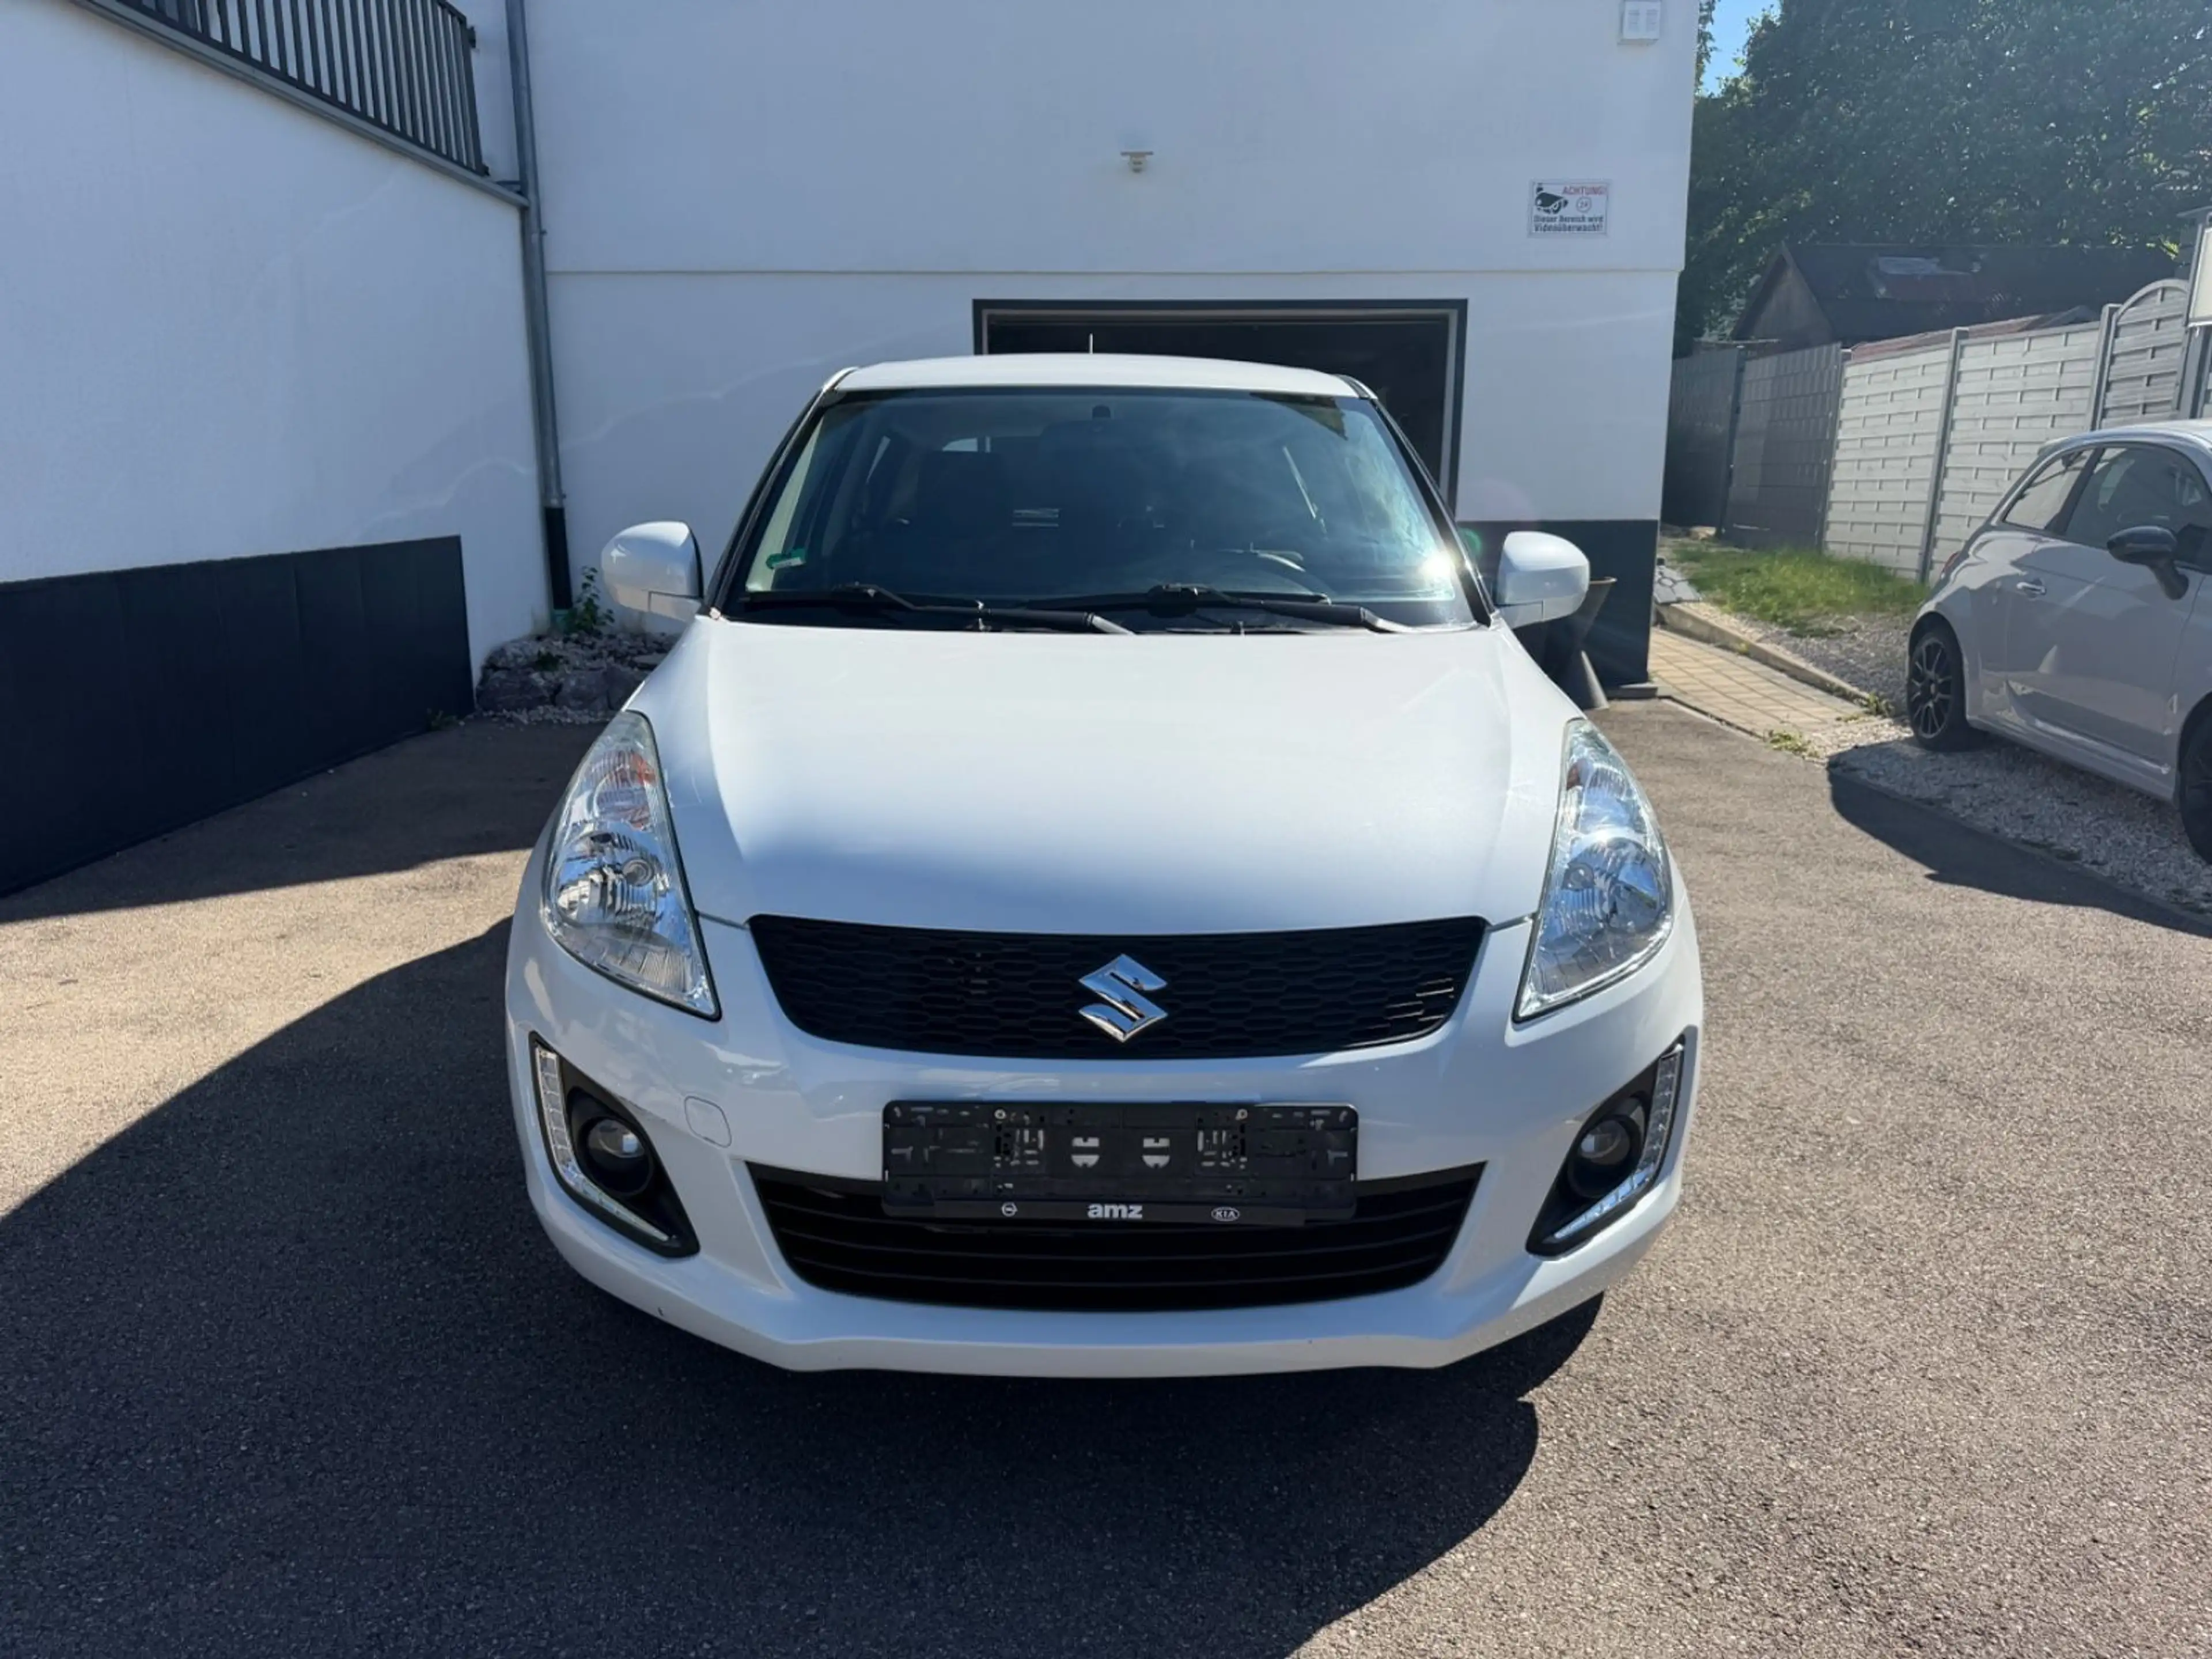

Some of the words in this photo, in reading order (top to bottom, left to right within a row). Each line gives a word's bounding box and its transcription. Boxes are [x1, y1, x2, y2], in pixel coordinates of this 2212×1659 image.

[1533, 214, 1558, 222] Dieser
[1559, 214, 1585, 222] Bereich
[1588, 214, 1604, 222] wird
[1088, 1203, 1142, 1218] amz
